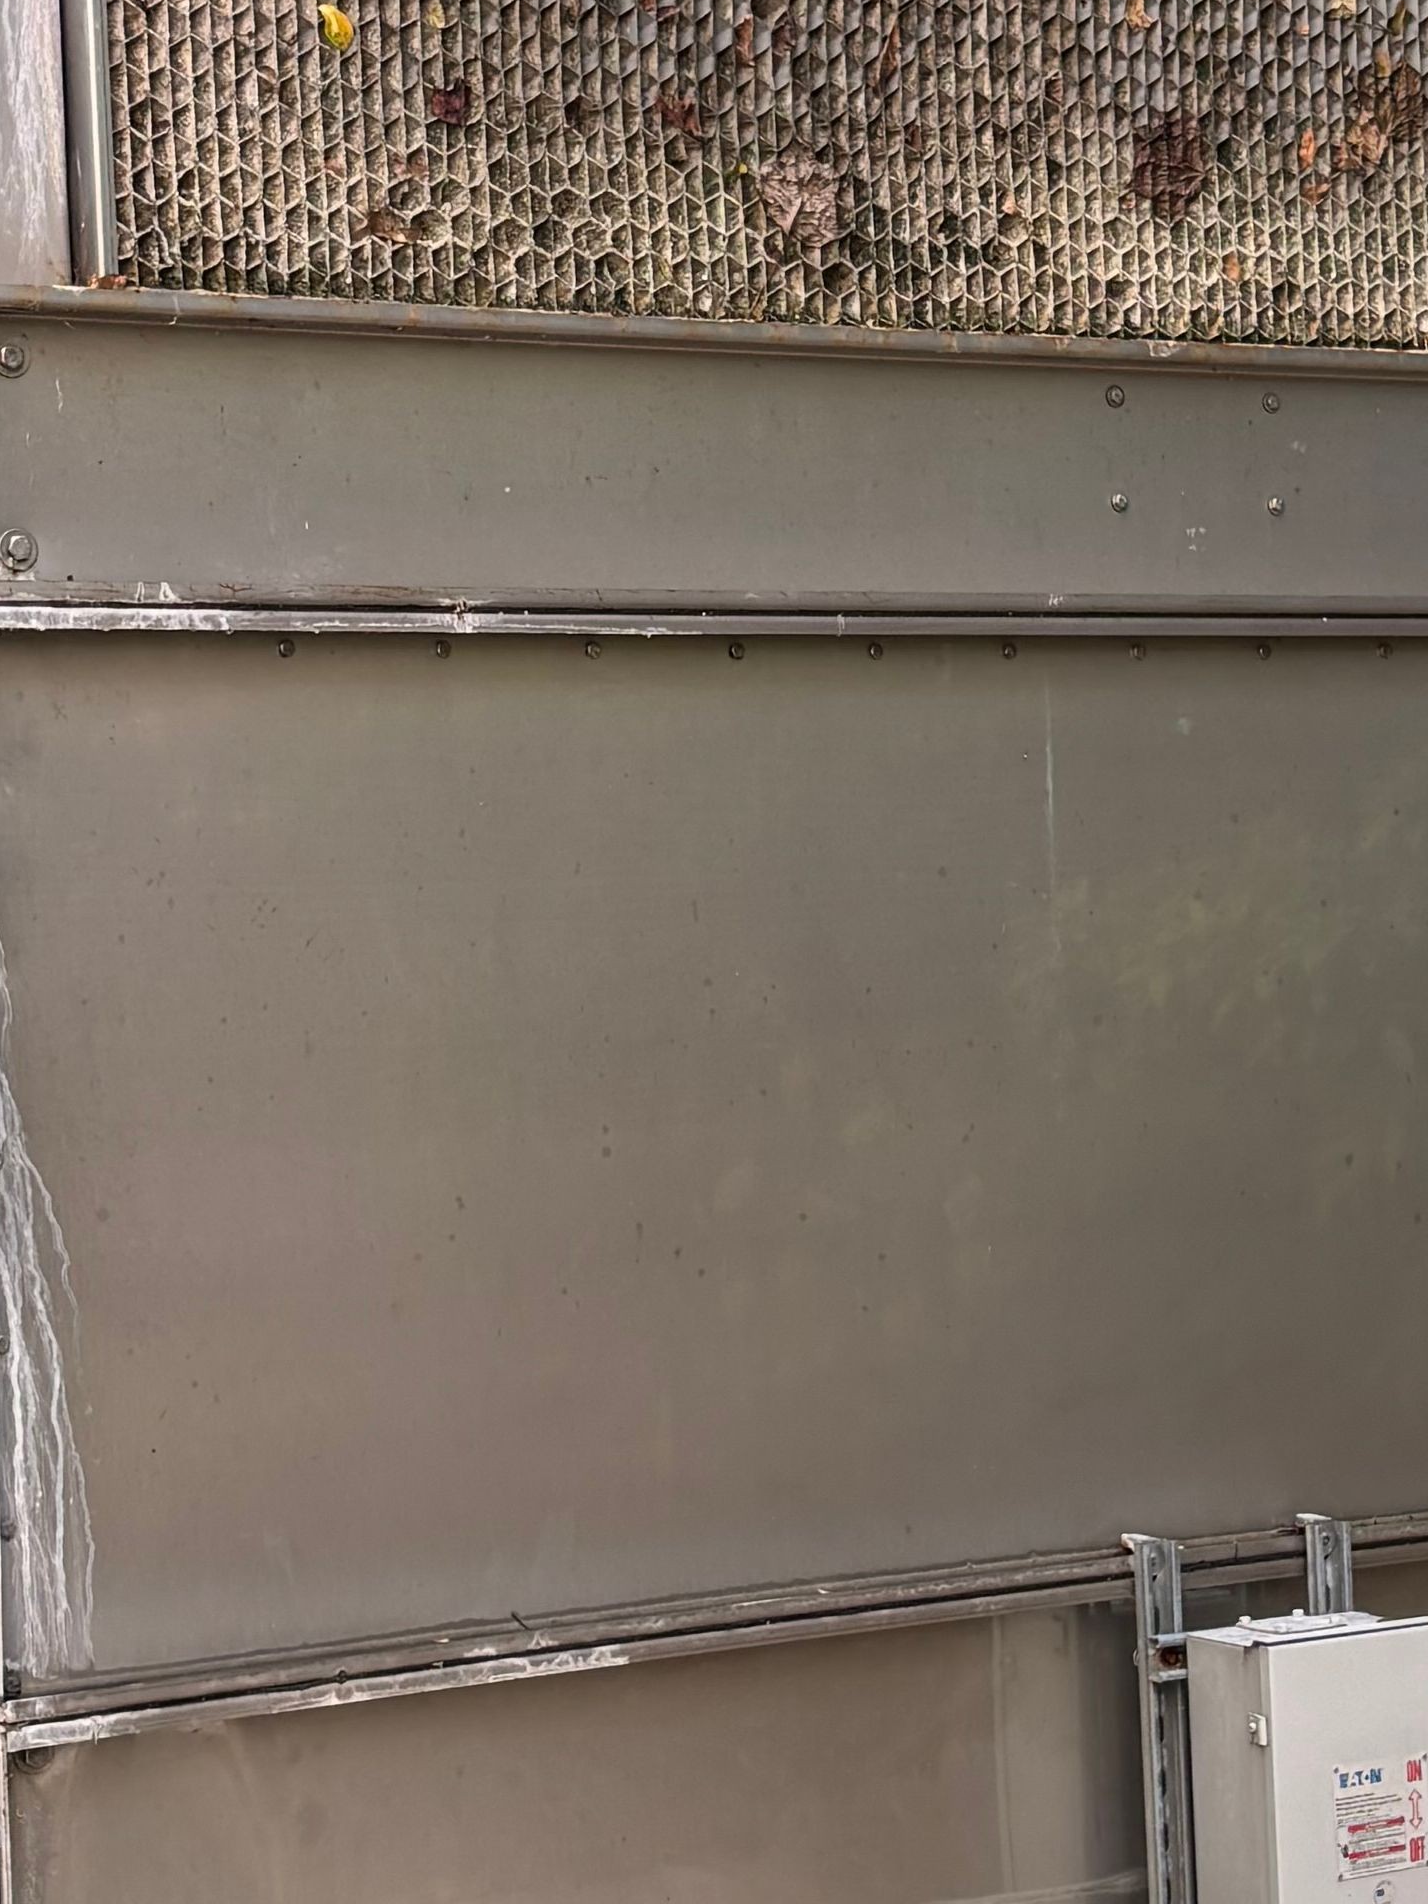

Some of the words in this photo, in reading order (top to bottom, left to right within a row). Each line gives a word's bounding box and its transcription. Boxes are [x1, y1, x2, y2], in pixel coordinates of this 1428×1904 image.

[1339, 1768, 1384, 1789] EATON
[1406, 1759, 1423, 1783] ON
[1409, 1836, 1426, 1863] OFF
